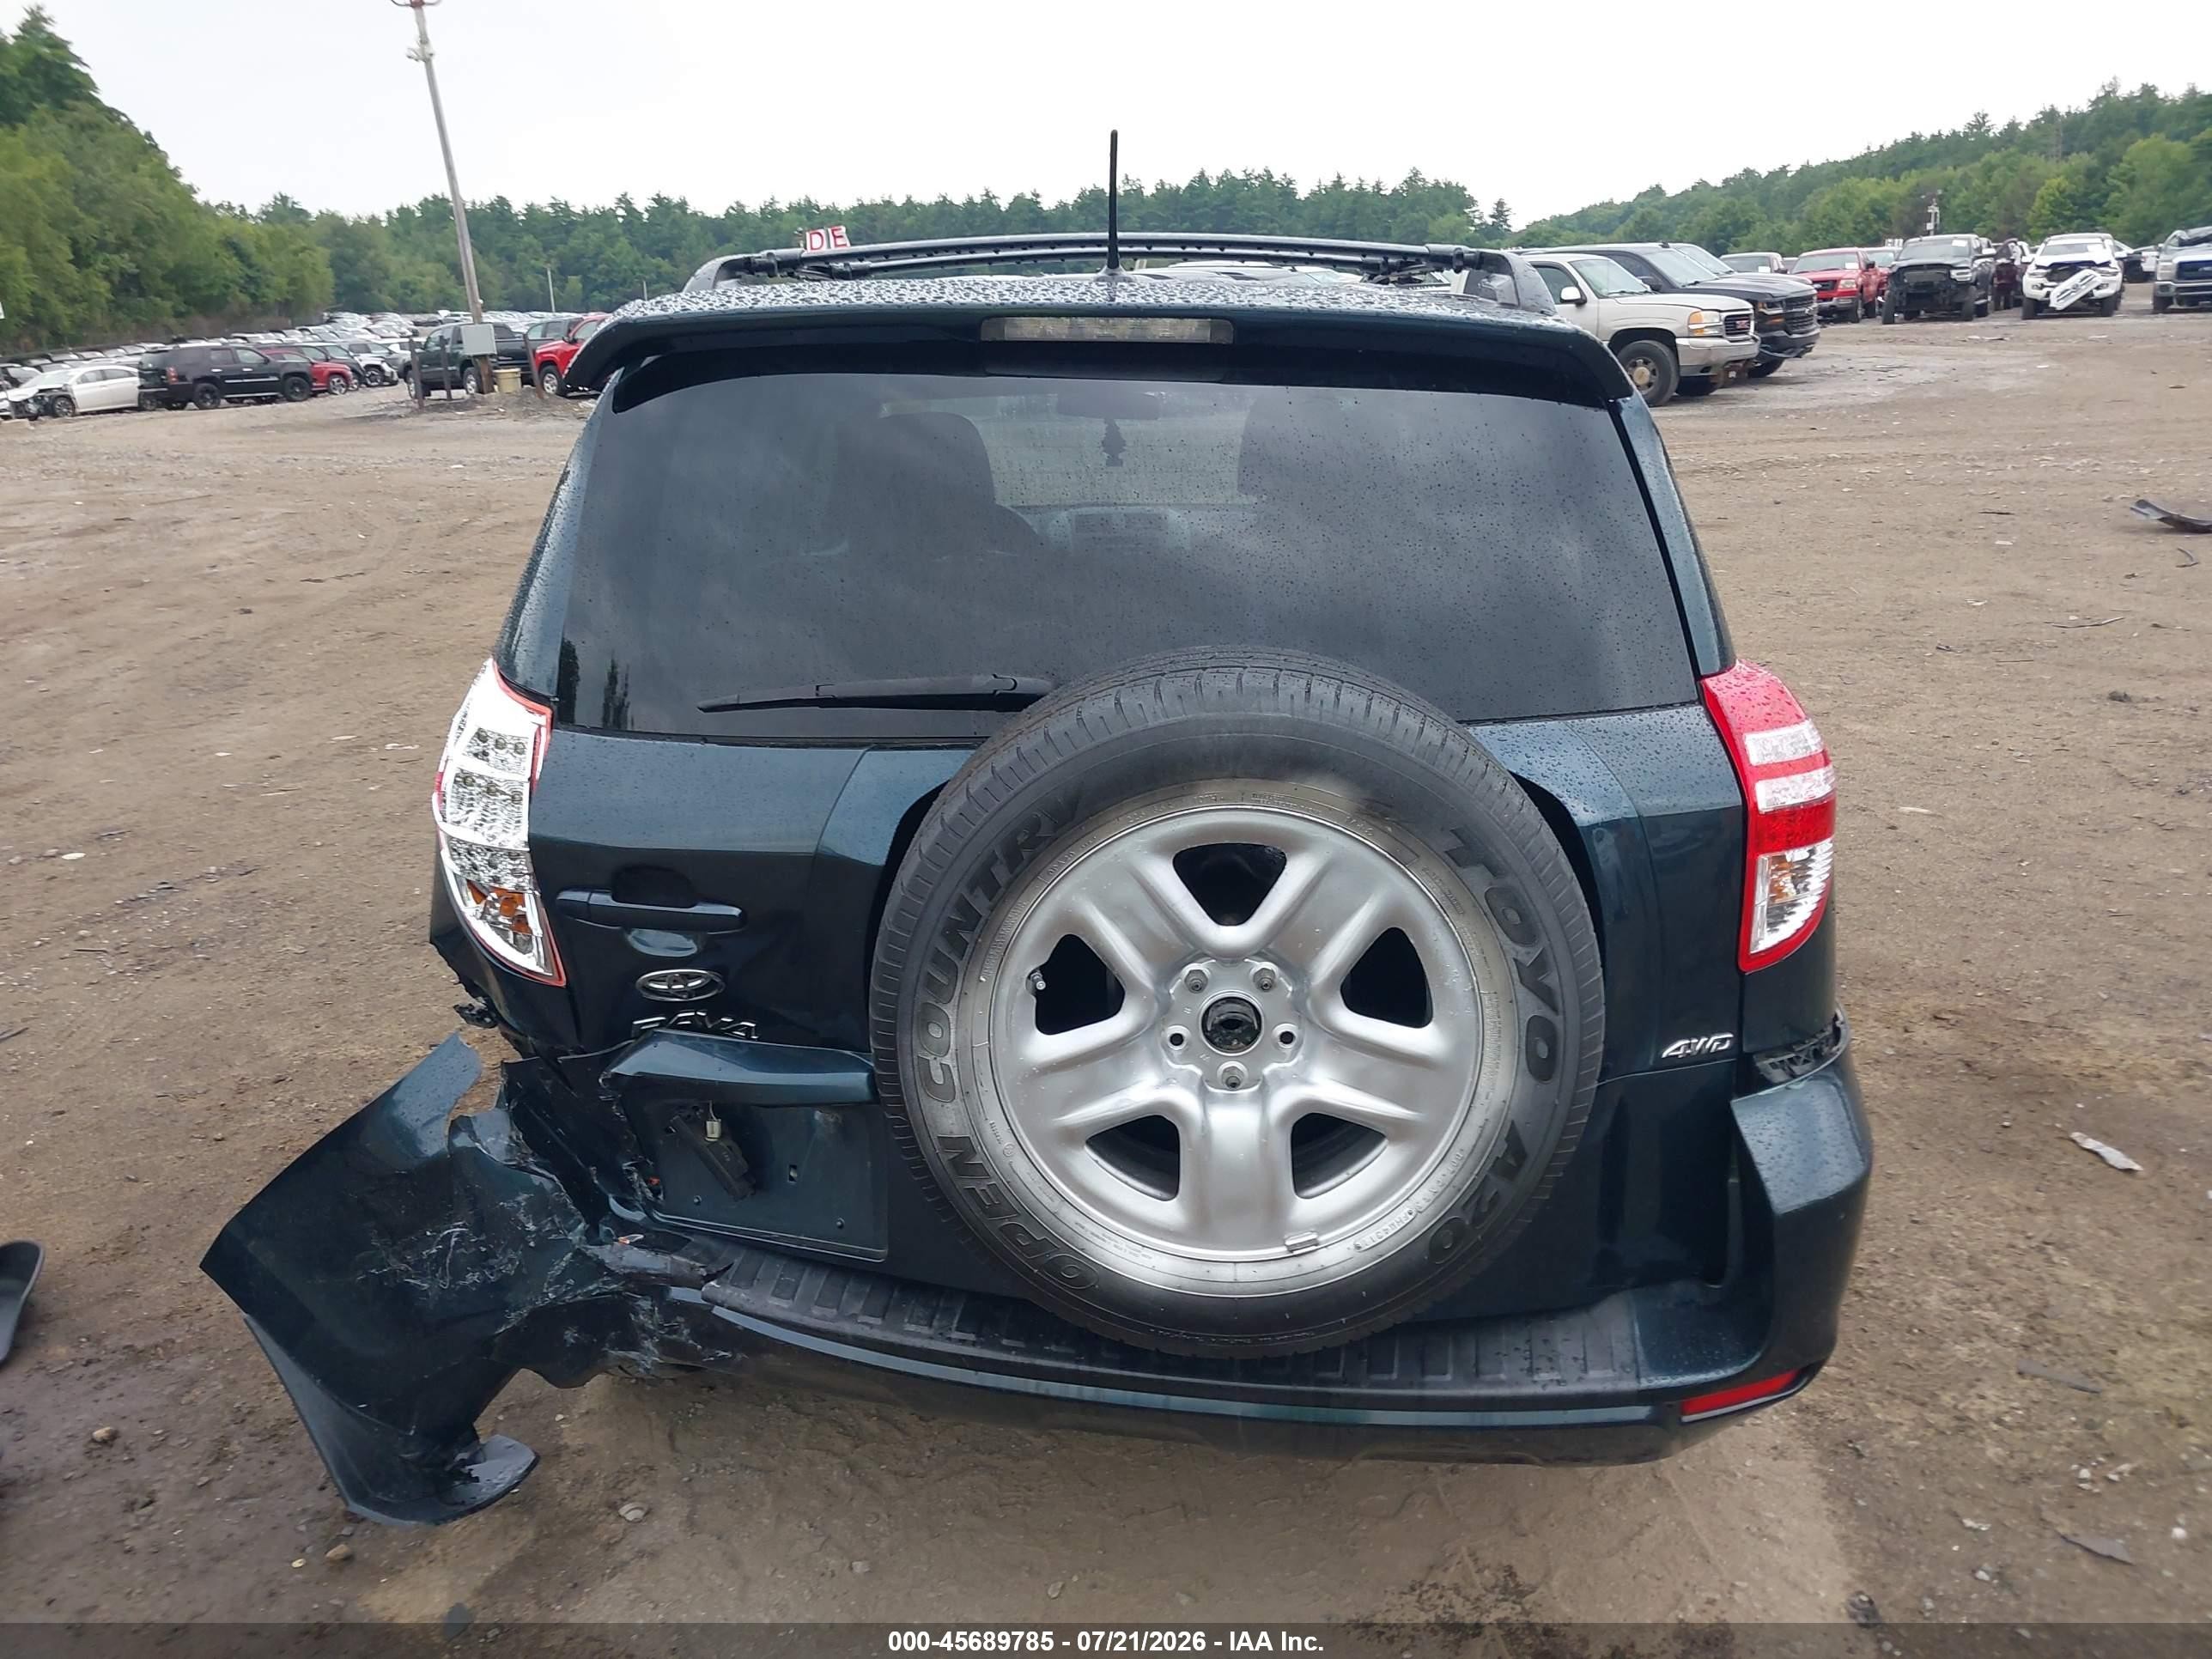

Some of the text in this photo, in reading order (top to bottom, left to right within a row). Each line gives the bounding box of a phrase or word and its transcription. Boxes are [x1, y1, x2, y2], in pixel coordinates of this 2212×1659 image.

[917, 783, 1101, 1291] OPEN COUNTRY
[1425, 828, 1559, 1267] TOYO A20
[1662, 1033, 1734, 1058] 4WD
